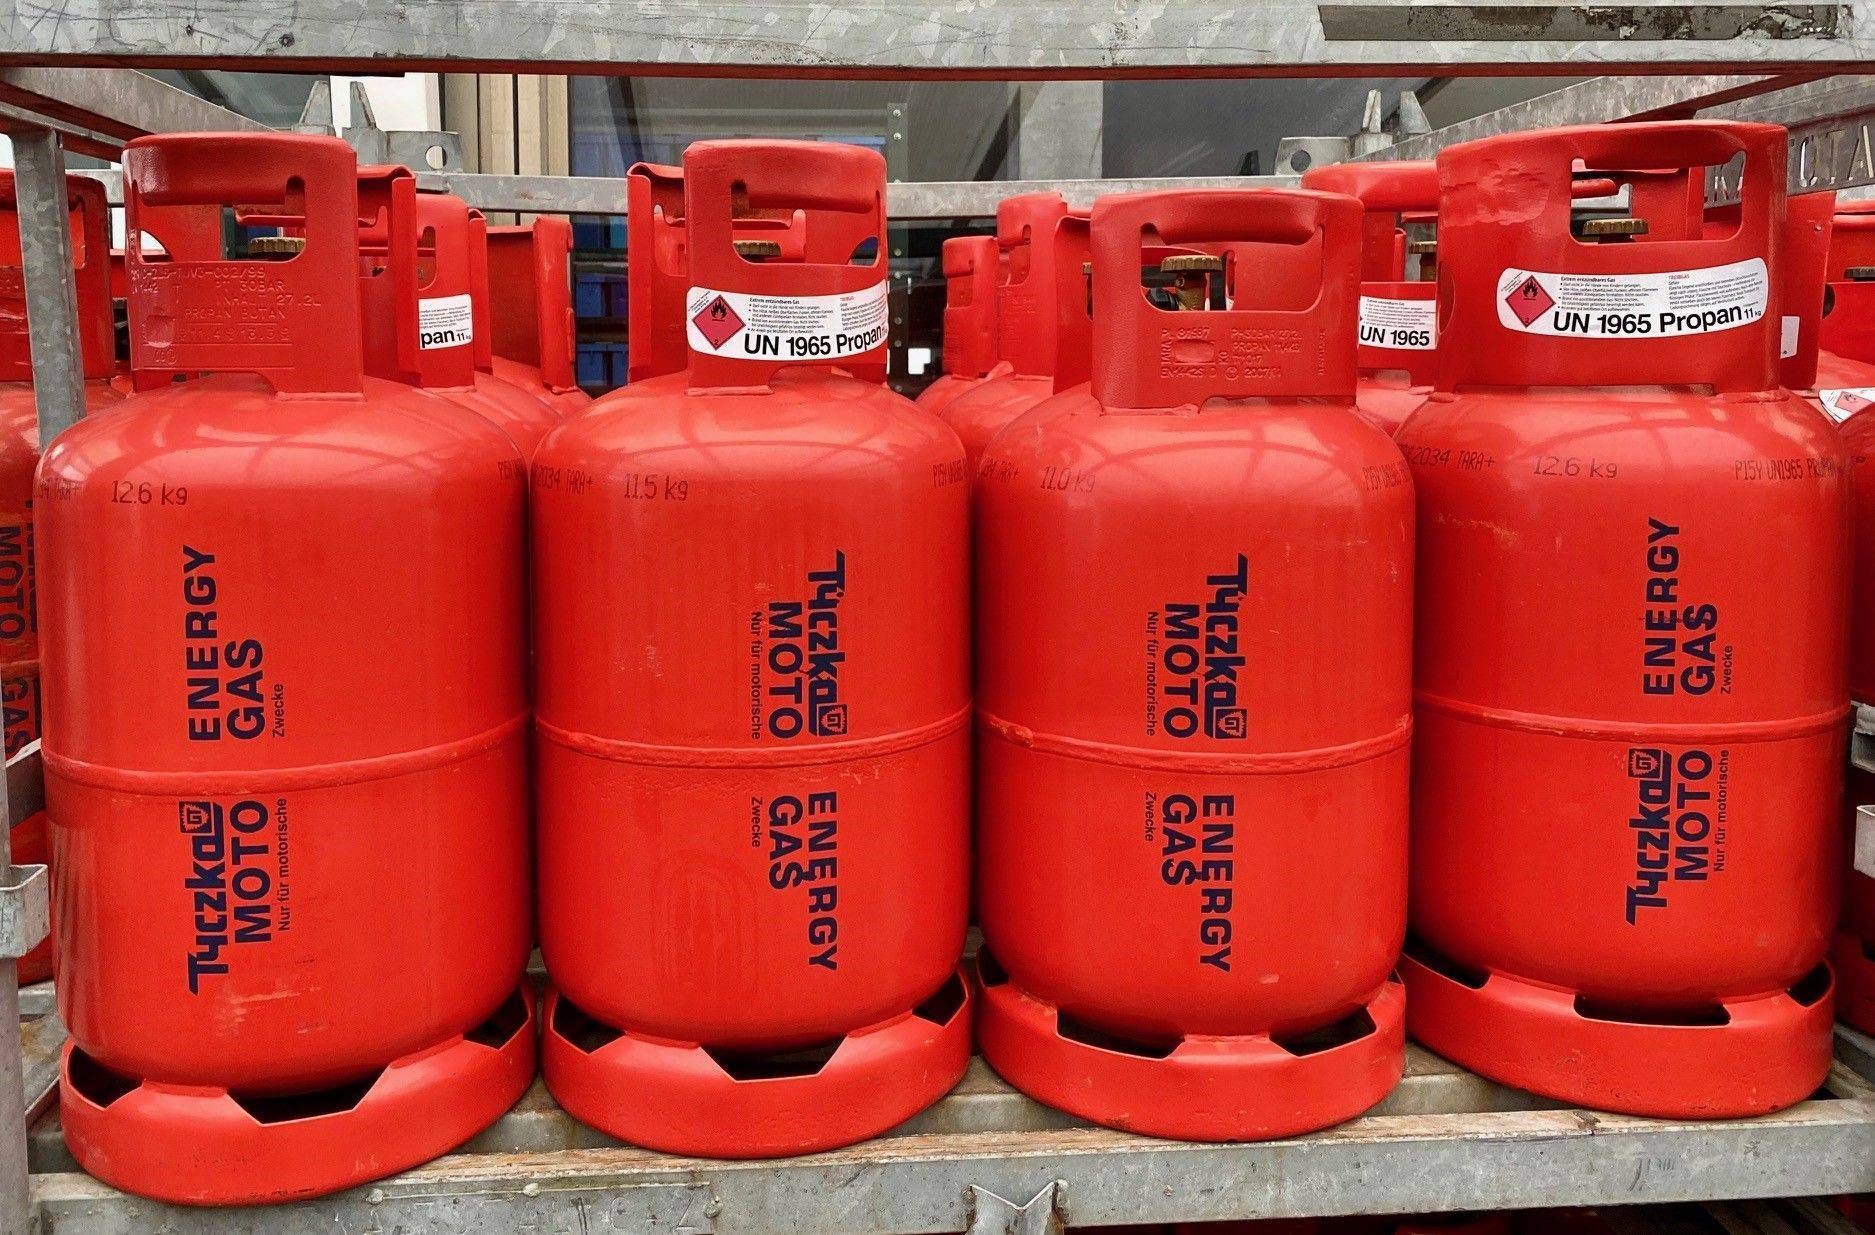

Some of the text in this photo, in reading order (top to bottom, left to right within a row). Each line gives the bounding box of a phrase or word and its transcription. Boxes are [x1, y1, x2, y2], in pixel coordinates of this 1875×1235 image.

[744, 333, 779, 356] UN
[785, 335, 831, 357] 1965
[836, 325, 882, 354] Propan
[1360, 325, 1430, 347] UN 1965
[1553, 310, 1590, 333] UN
[1596, 313, 1652, 334] 1965
[1659, 305, 1742, 333] Propan
[1744, 307, 1754, 319] 11
[111, 479, 188, 506] 12.6 kg
[624, 472, 689, 502] 11.5 kg
[1458, 449, 1496, 473] TARA+
[1533, 454, 1619, 479] 12.6 kg
[0, 526, 26, 639] MOTO
[182, 544, 221, 741] ENERGY
[807, 549, 846, 737] Tyczka
[1203, 552, 1249, 738] Tyczka
[1643, 517, 1680, 695] ENERGY
[1680, 603, 1719, 696] GAS
[223, 638, 265, 740] GAS
[750, 611, 764, 849] Nur für motorische Zwecke
[768, 601, 804, 739] MOTO
[1144, 611, 1159, 842] Nur für motorische Zwecke
[1163, 603, 1200, 739] MOTO
[271, 683, 291, 932] Nur für motorische Zwecke
[1674, 750, 1713, 881] MOTO
[1714, 645, 1734, 872] Nur für motorische Zwecke
[184, 801, 229, 996] Tyczka
[229, 800, 272, 944] MOTO
[768, 795, 804, 890] GAS
[807, 791, 839, 971] ENERGY
[1161, 794, 1199, 886] GAS
[1200, 794, 1235, 973] ENERGY
[1625, 750, 1673, 926] Tyczka
